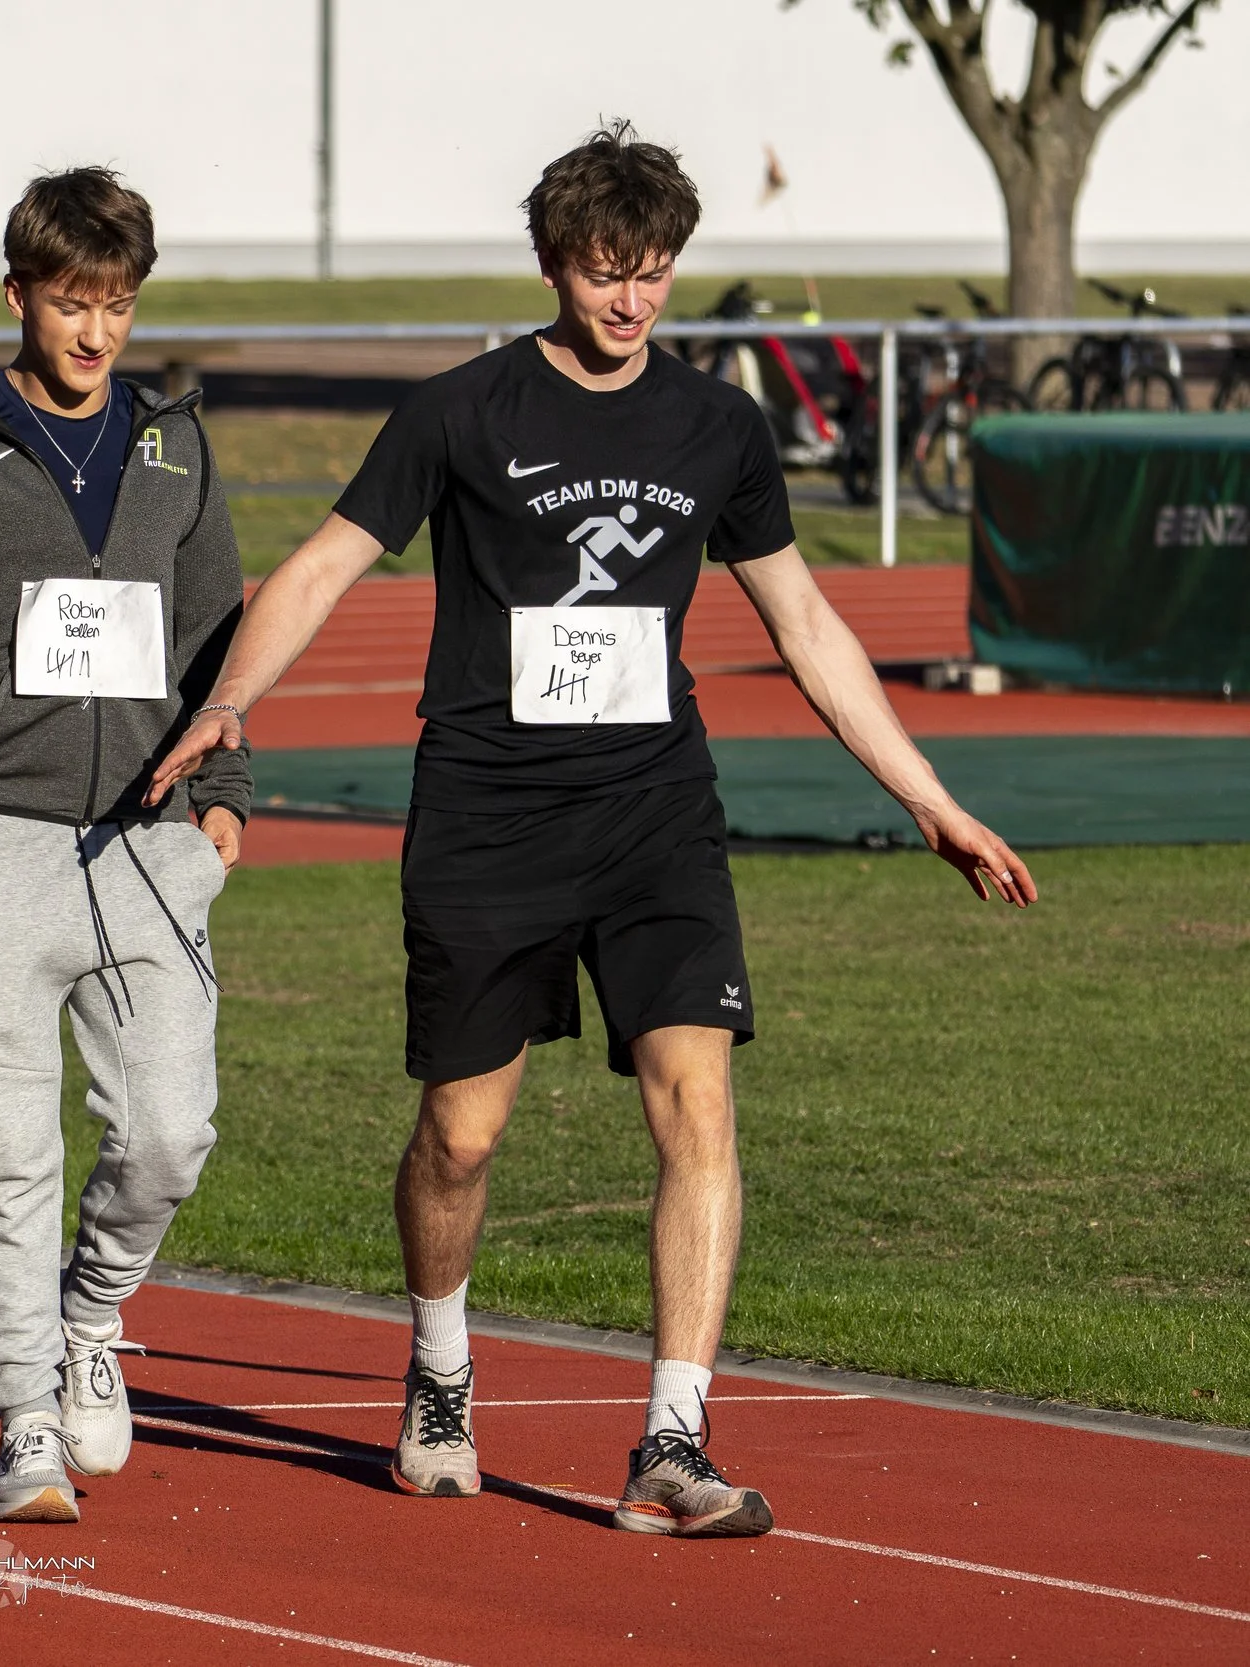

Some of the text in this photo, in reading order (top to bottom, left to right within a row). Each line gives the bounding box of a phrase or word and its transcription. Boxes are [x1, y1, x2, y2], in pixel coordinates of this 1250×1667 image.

[527, 479, 695, 516] TEAM DM 2026
[57, 593, 106, 621] Robin
[552, 624, 617, 647] Dennis
[570, 650, 602, 670] Beyer
[720, 997, 742, 1010] erima
